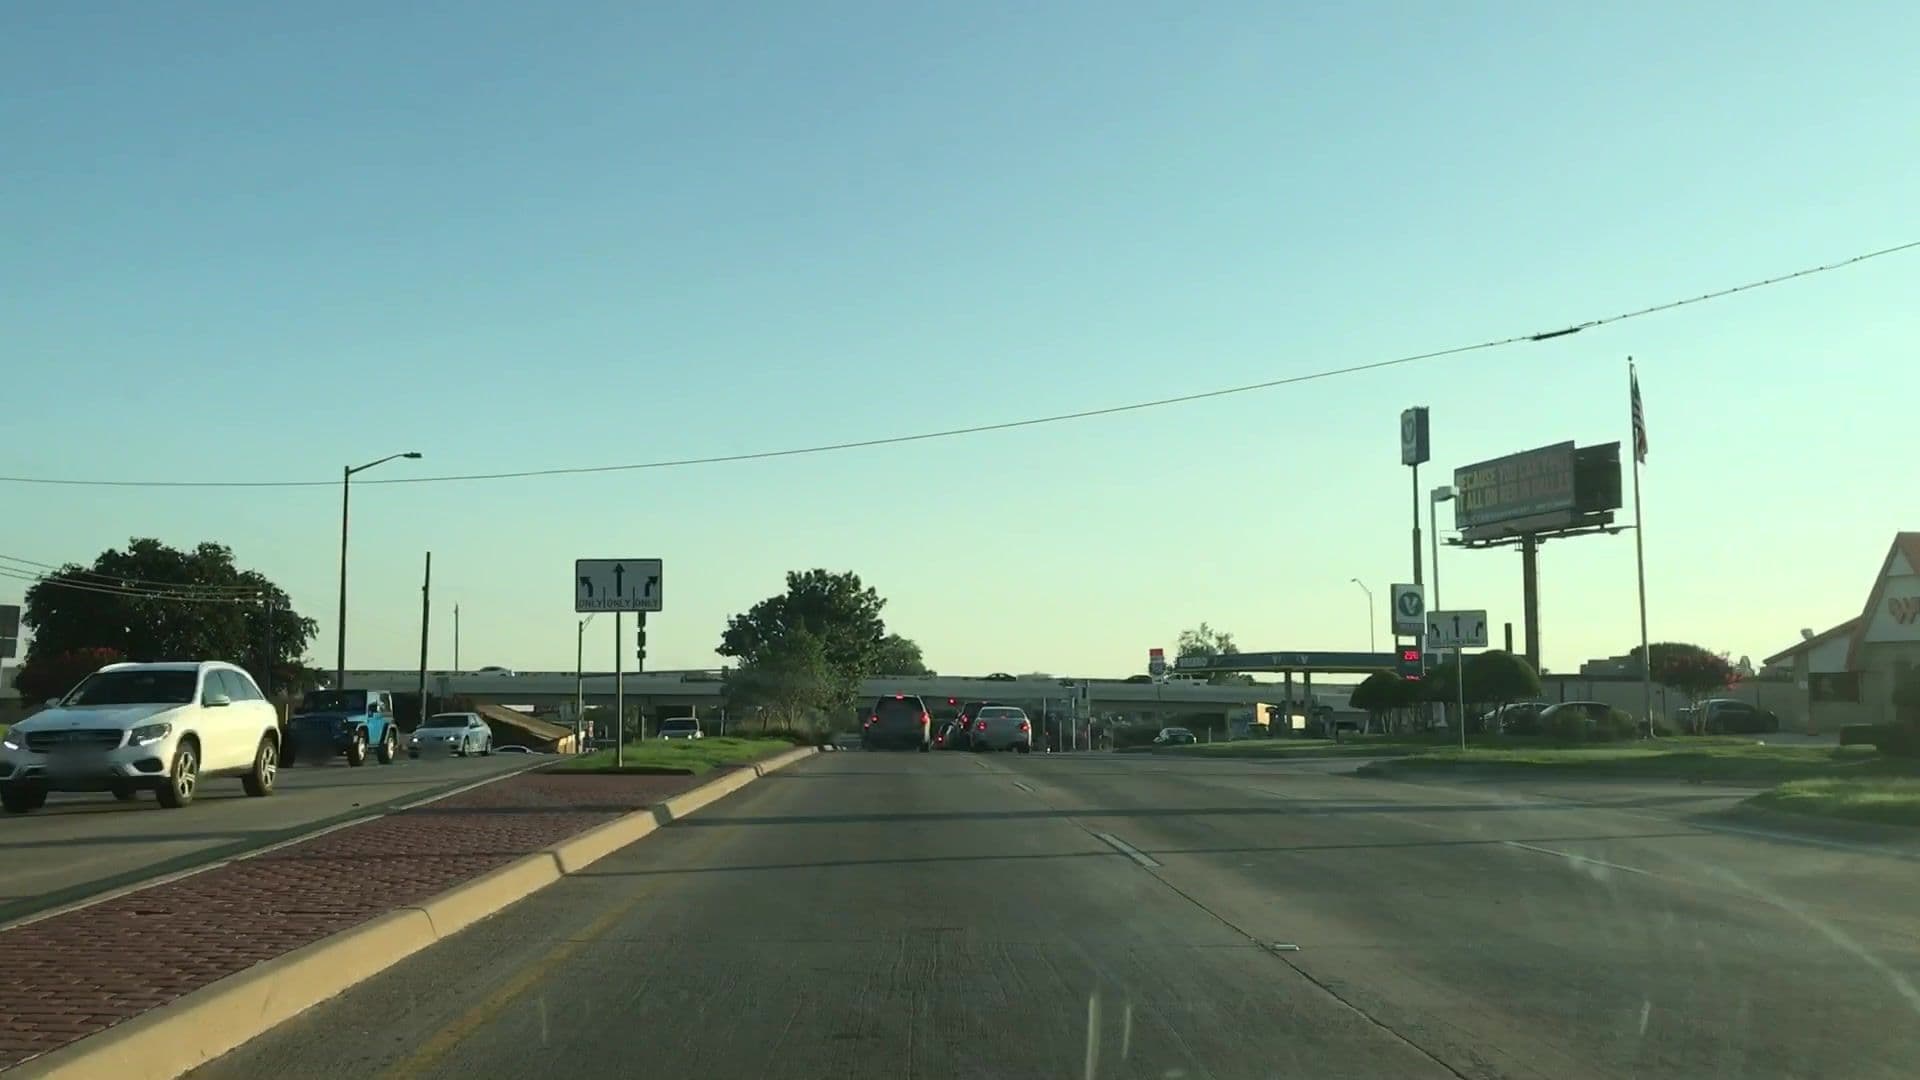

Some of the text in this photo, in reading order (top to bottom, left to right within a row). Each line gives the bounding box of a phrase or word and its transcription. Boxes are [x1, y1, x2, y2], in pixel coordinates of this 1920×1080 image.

[1467, 487, 1484, 510] ALL
[1485, 485, 1498, 505] ON
[578, 599, 658, 608] ONLY ONLY ONLY
